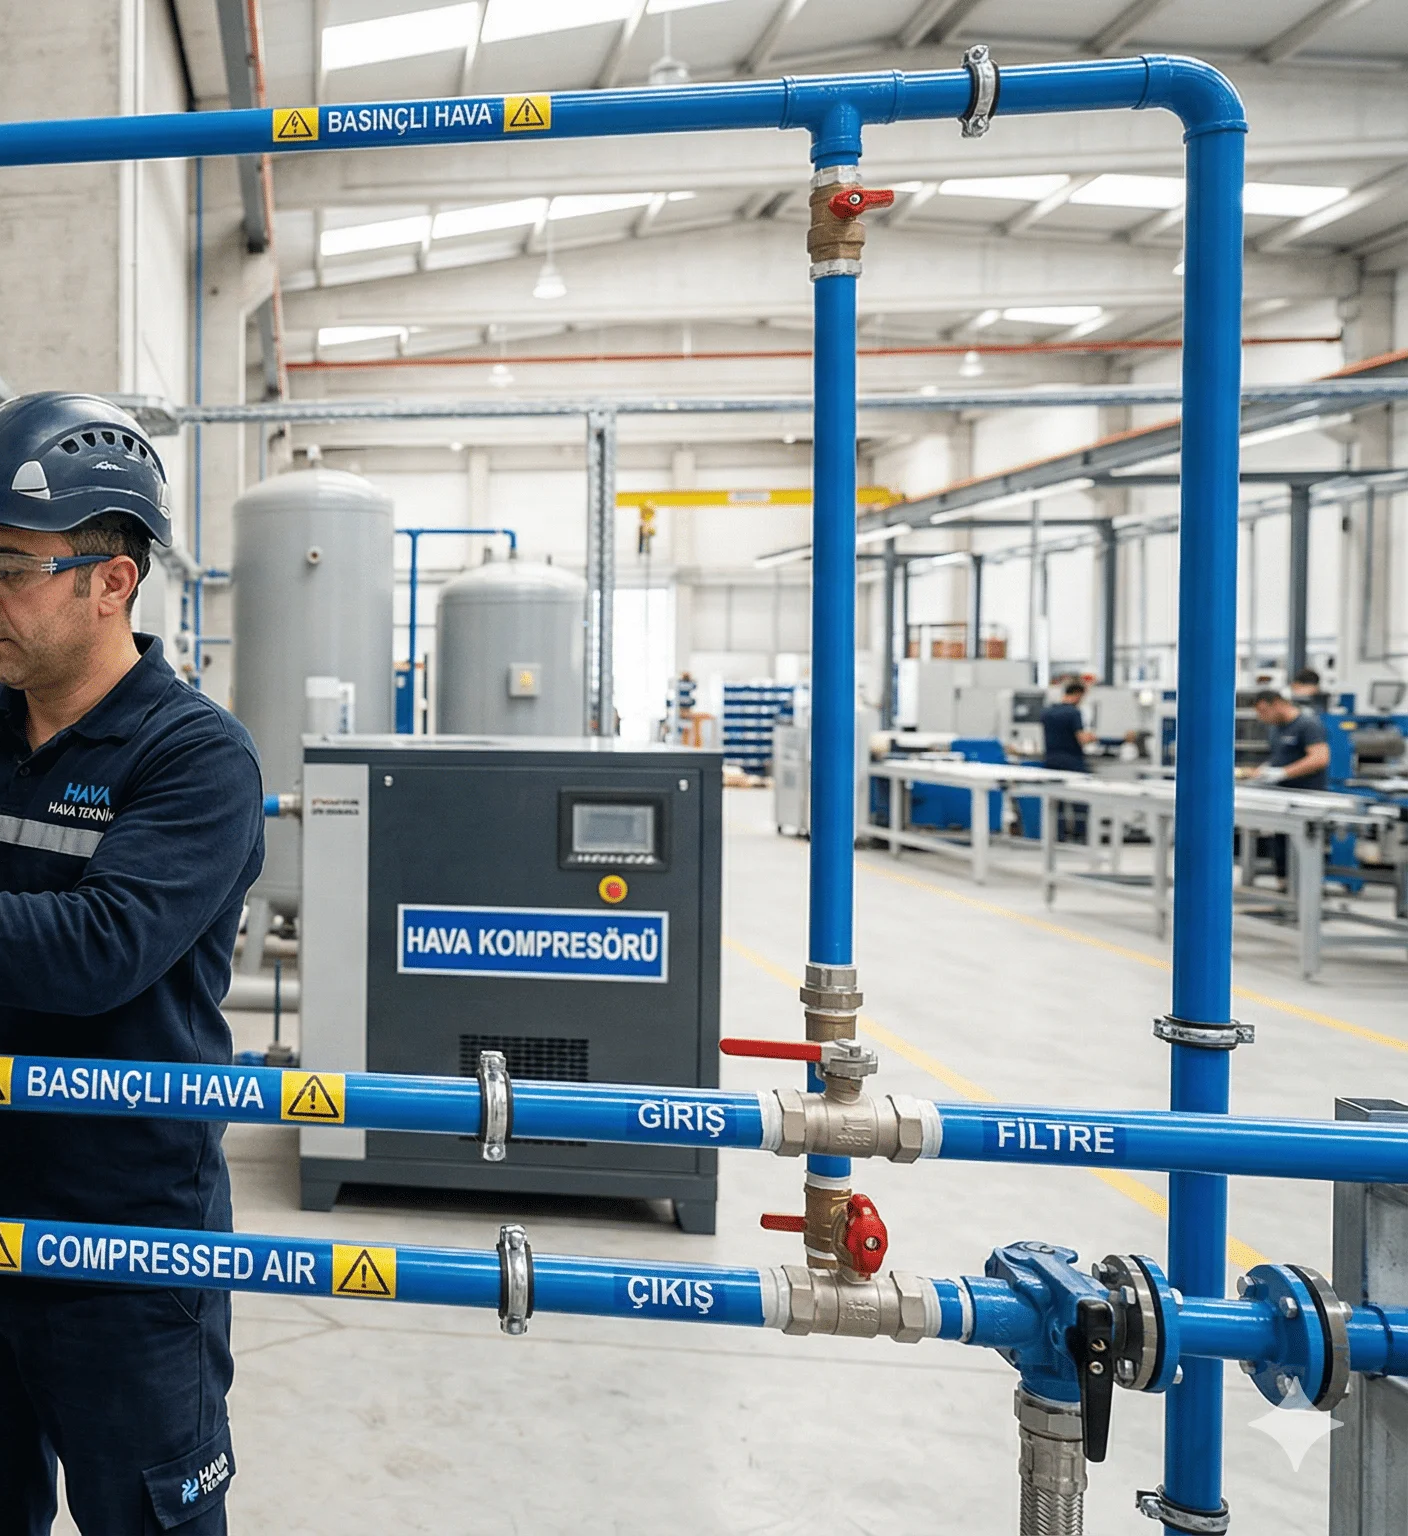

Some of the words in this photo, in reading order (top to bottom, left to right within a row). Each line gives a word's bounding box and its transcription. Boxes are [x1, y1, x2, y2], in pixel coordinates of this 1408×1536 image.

[328, 105, 428, 136] BASINÇLI
[435, 103, 493, 128] HAVA
[48, 801, 76, 817] HAVA
[63, 782, 111, 806] HAVA
[407, 926, 473, 955] HAVA
[479, 926, 659, 962] KOMPRESÖRÜ
[27, 1066, 170, 1109] BASINÇLI
[181, 1073, 264, 1109] HAVA
[997, 1117, 1115, 1154] FİLTRE
[37, 1234, 254, 1280] COMPRESSED
[262, 1250, 317, 1285] AIR
[627, 1276, 714, 1314] ÇIKIŞ
